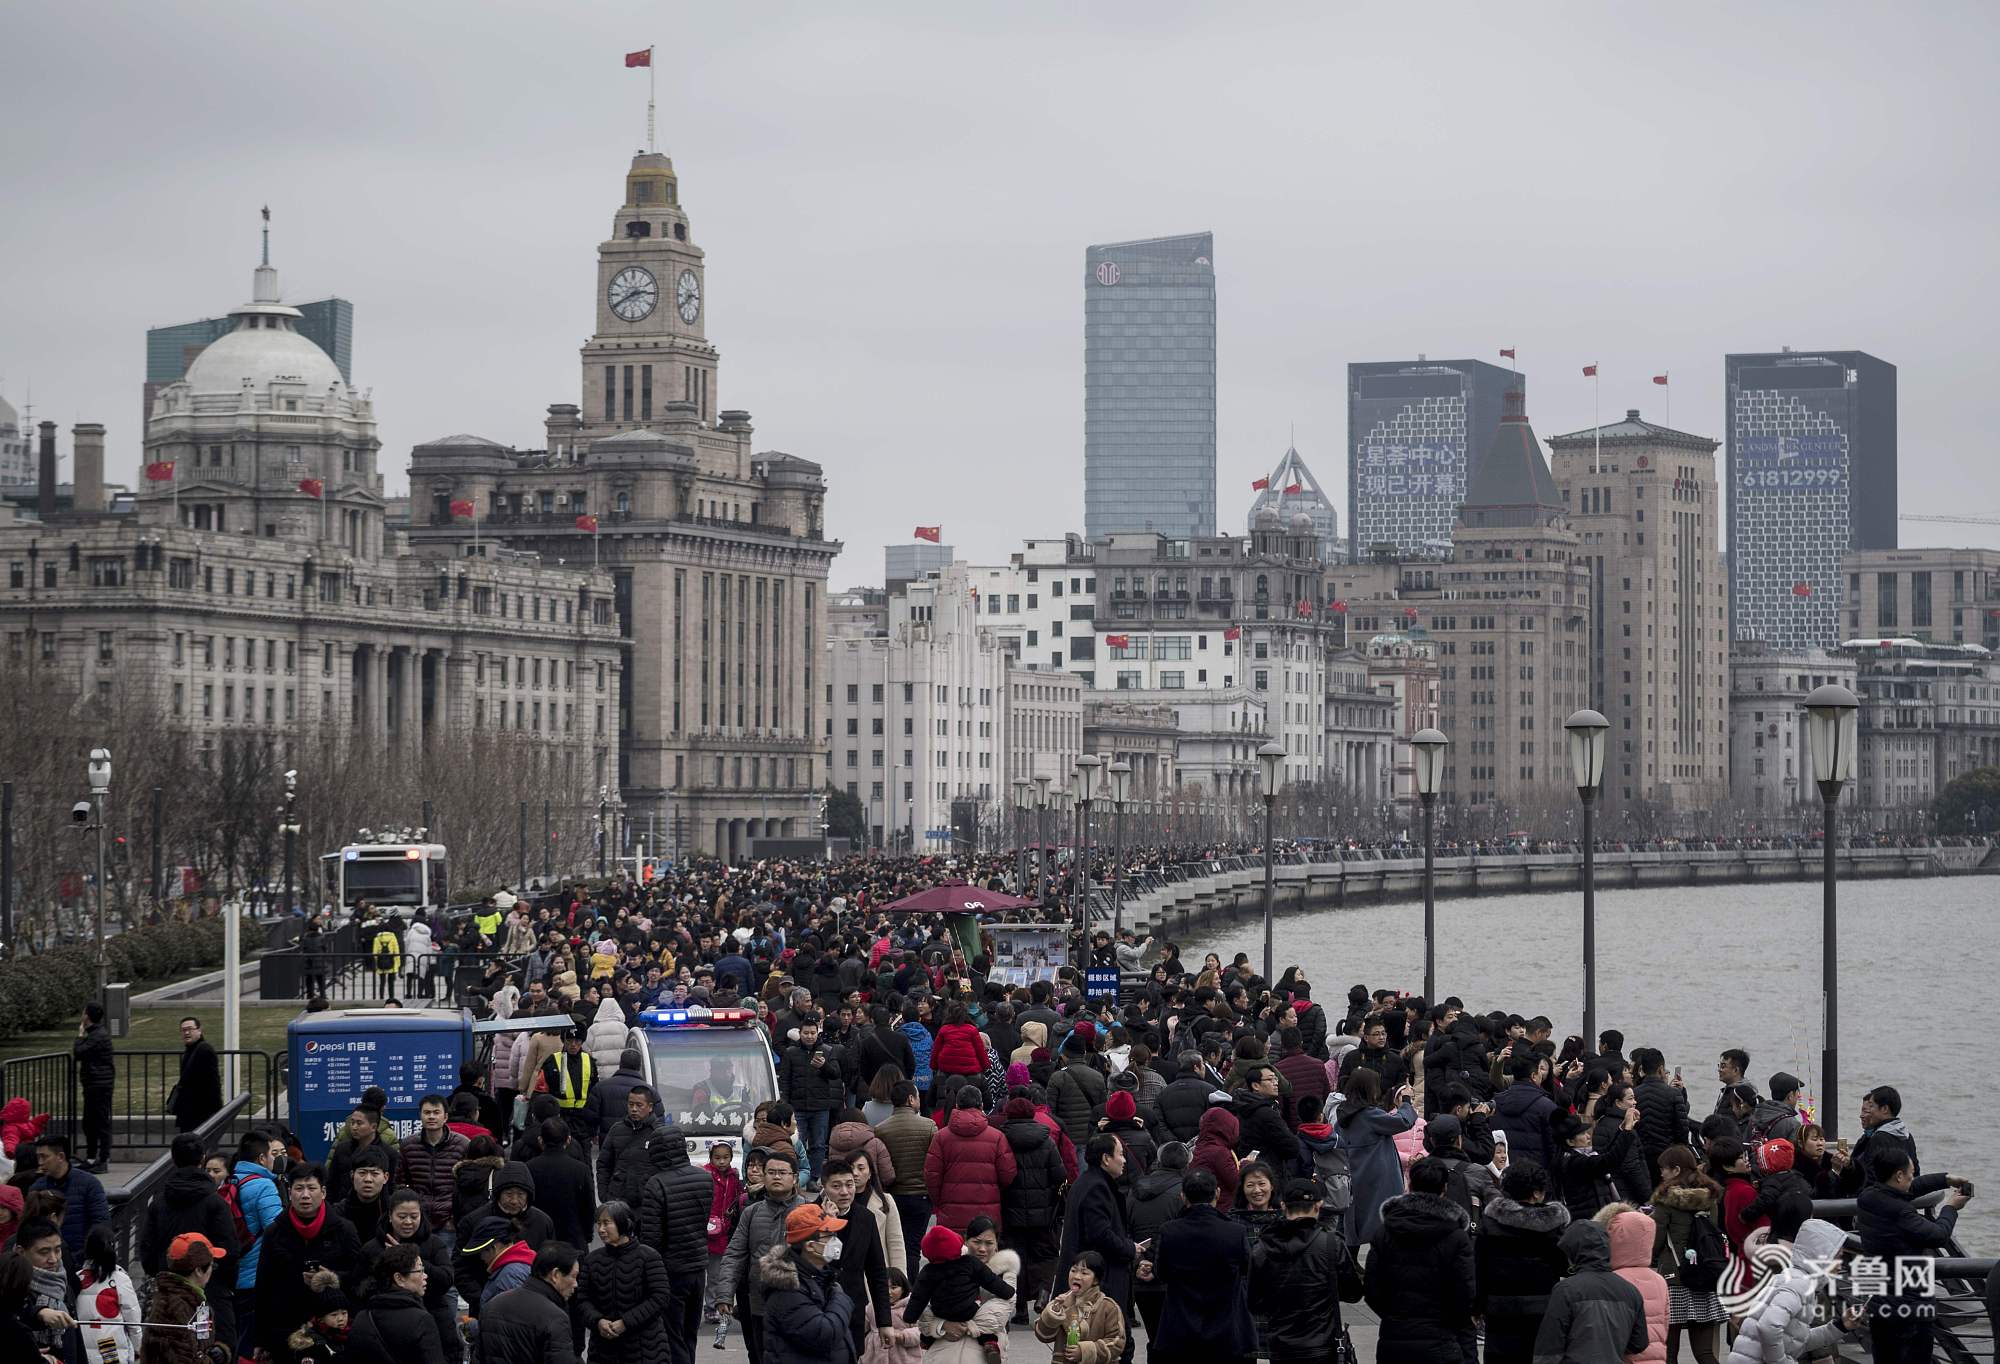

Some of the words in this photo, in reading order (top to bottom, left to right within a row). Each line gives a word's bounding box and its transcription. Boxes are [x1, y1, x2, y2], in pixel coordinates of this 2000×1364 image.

[1366, 444, 1456, 466] 星荟中心
[1742, 442, 1800, 451] LANDMRK
[1365, 474, 1455, 495] 现已开幕
[1743, 469, 1841, 486] 61812999
[319, 1042, 345, 1052] pepsi
[347, 1041, 376, 1051] 价目表
